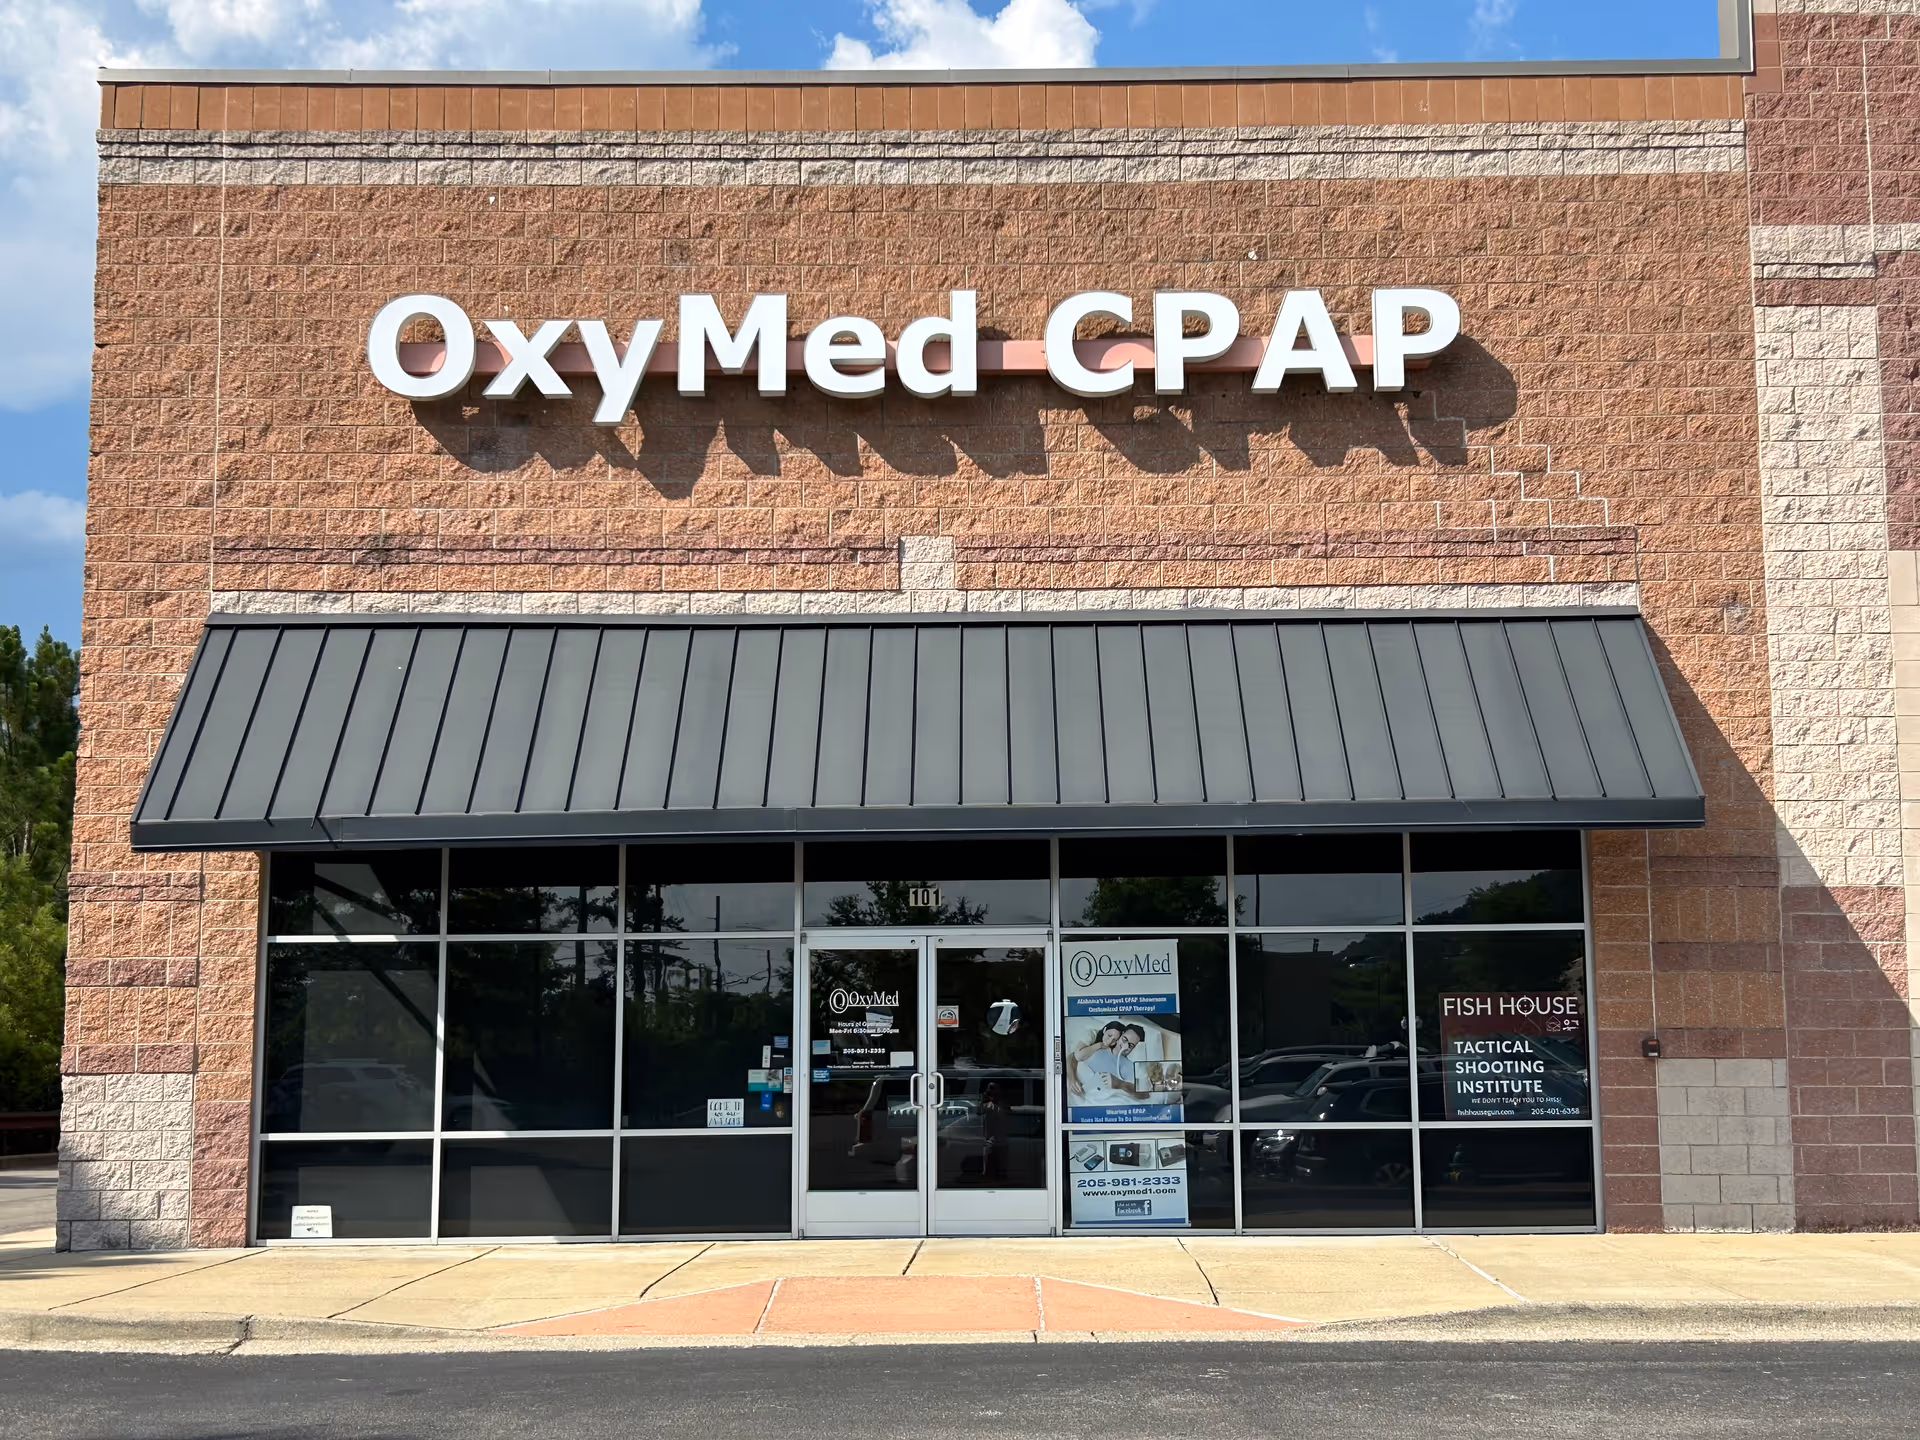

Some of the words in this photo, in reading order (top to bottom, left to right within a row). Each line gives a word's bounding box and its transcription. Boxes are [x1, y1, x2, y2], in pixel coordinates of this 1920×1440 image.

[367, 289, 979, 425] OxyMed
[1045, 286, 1462, 398] CPAP
[911, 888, 940, 906] 101
[1098, 952, 1171, 979] OxyMed
[849, 990, 899, 1009] OxyMed
[1443, 997, 1492, 1016] FISH
[1500, 995, 1578, 1017] HOUSE
[1454, 1040, 1534, 1054] TACTICAL
[1455, 1061, 1545, 1074] SHOOTING
[1456, 1080, 1543, 1094] INSTITUTE
[1531, 1107, 1580, 1115] 205-401-6358
[1077, 1176, 1181, 1188] 205-981-2333
[1082, 1186, 1176, 1196] www.oxymed1.com
